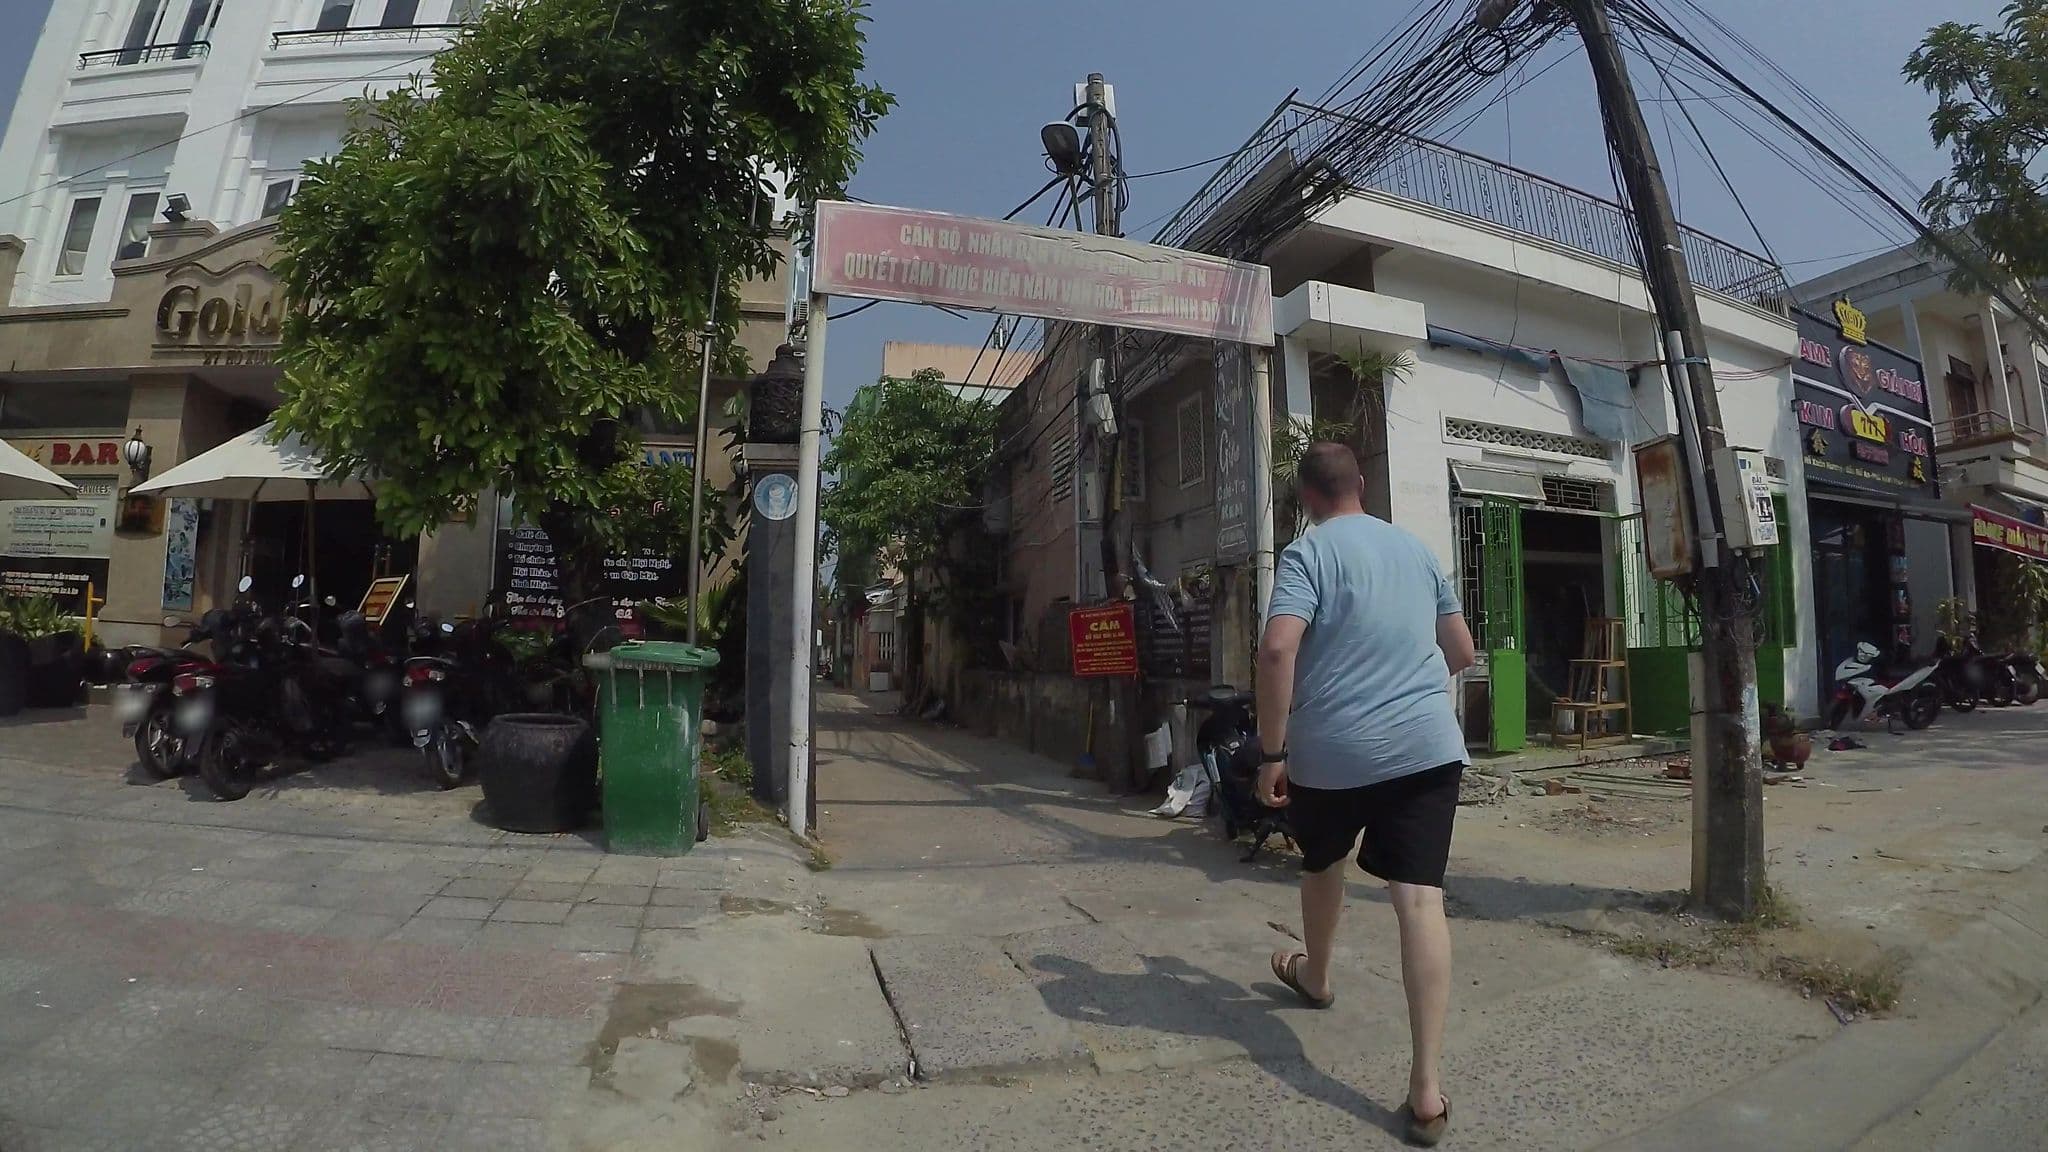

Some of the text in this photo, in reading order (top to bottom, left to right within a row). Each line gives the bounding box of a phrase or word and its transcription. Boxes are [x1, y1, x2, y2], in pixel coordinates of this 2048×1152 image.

[900, 222, 936, 249] CÁN
[937, 226, 964, 256] BỘ,
[844, 249, 899, 282] QUYẾT
[901, 256, 936, 288] TÂM
[1799, 400, 1835, 430] KIM
[51, 443, 120, 465] BAR
